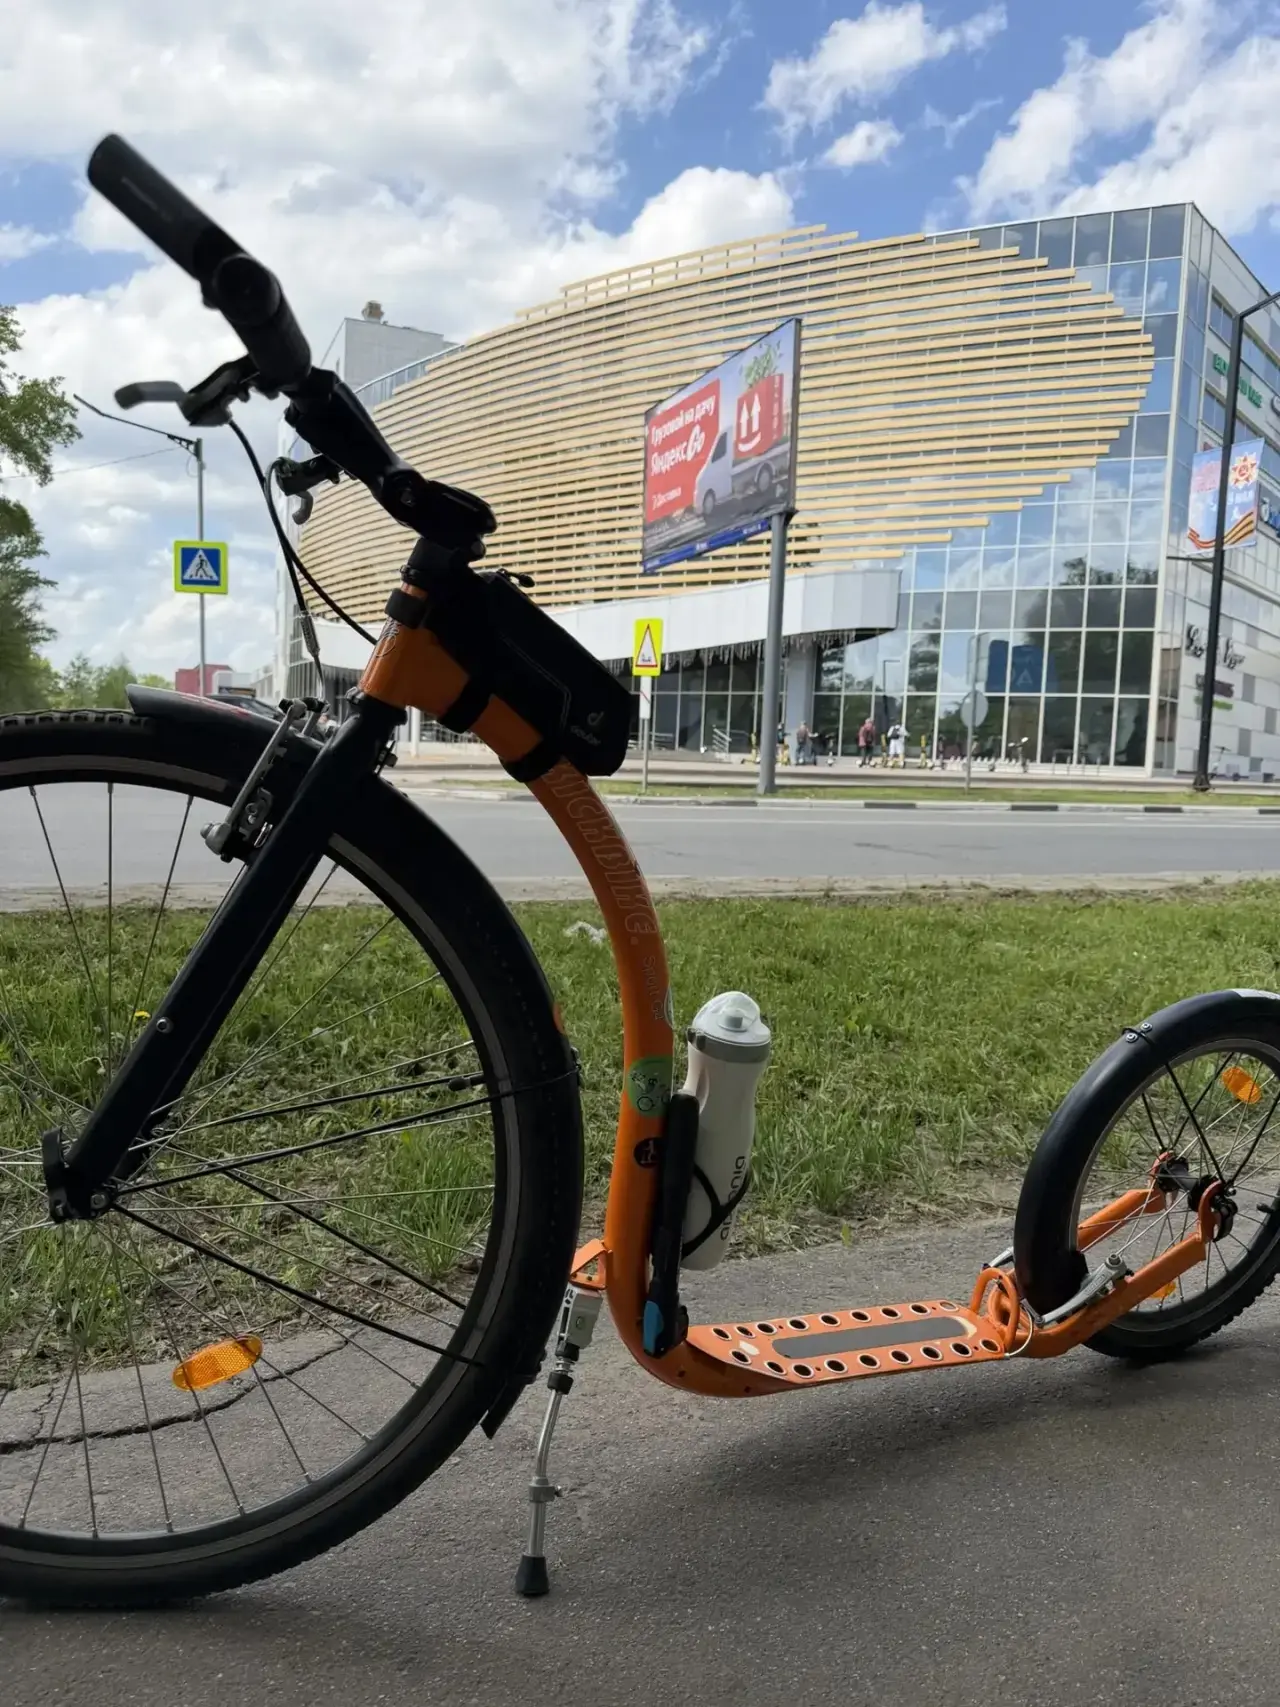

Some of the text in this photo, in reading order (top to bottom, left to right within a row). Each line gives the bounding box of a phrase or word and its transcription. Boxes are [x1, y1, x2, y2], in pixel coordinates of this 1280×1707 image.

[695, 395, 716, 422] дачу
[651, 424, 706, 477] Яндекс Go
[720, 1156, 746, 1241] aonia
